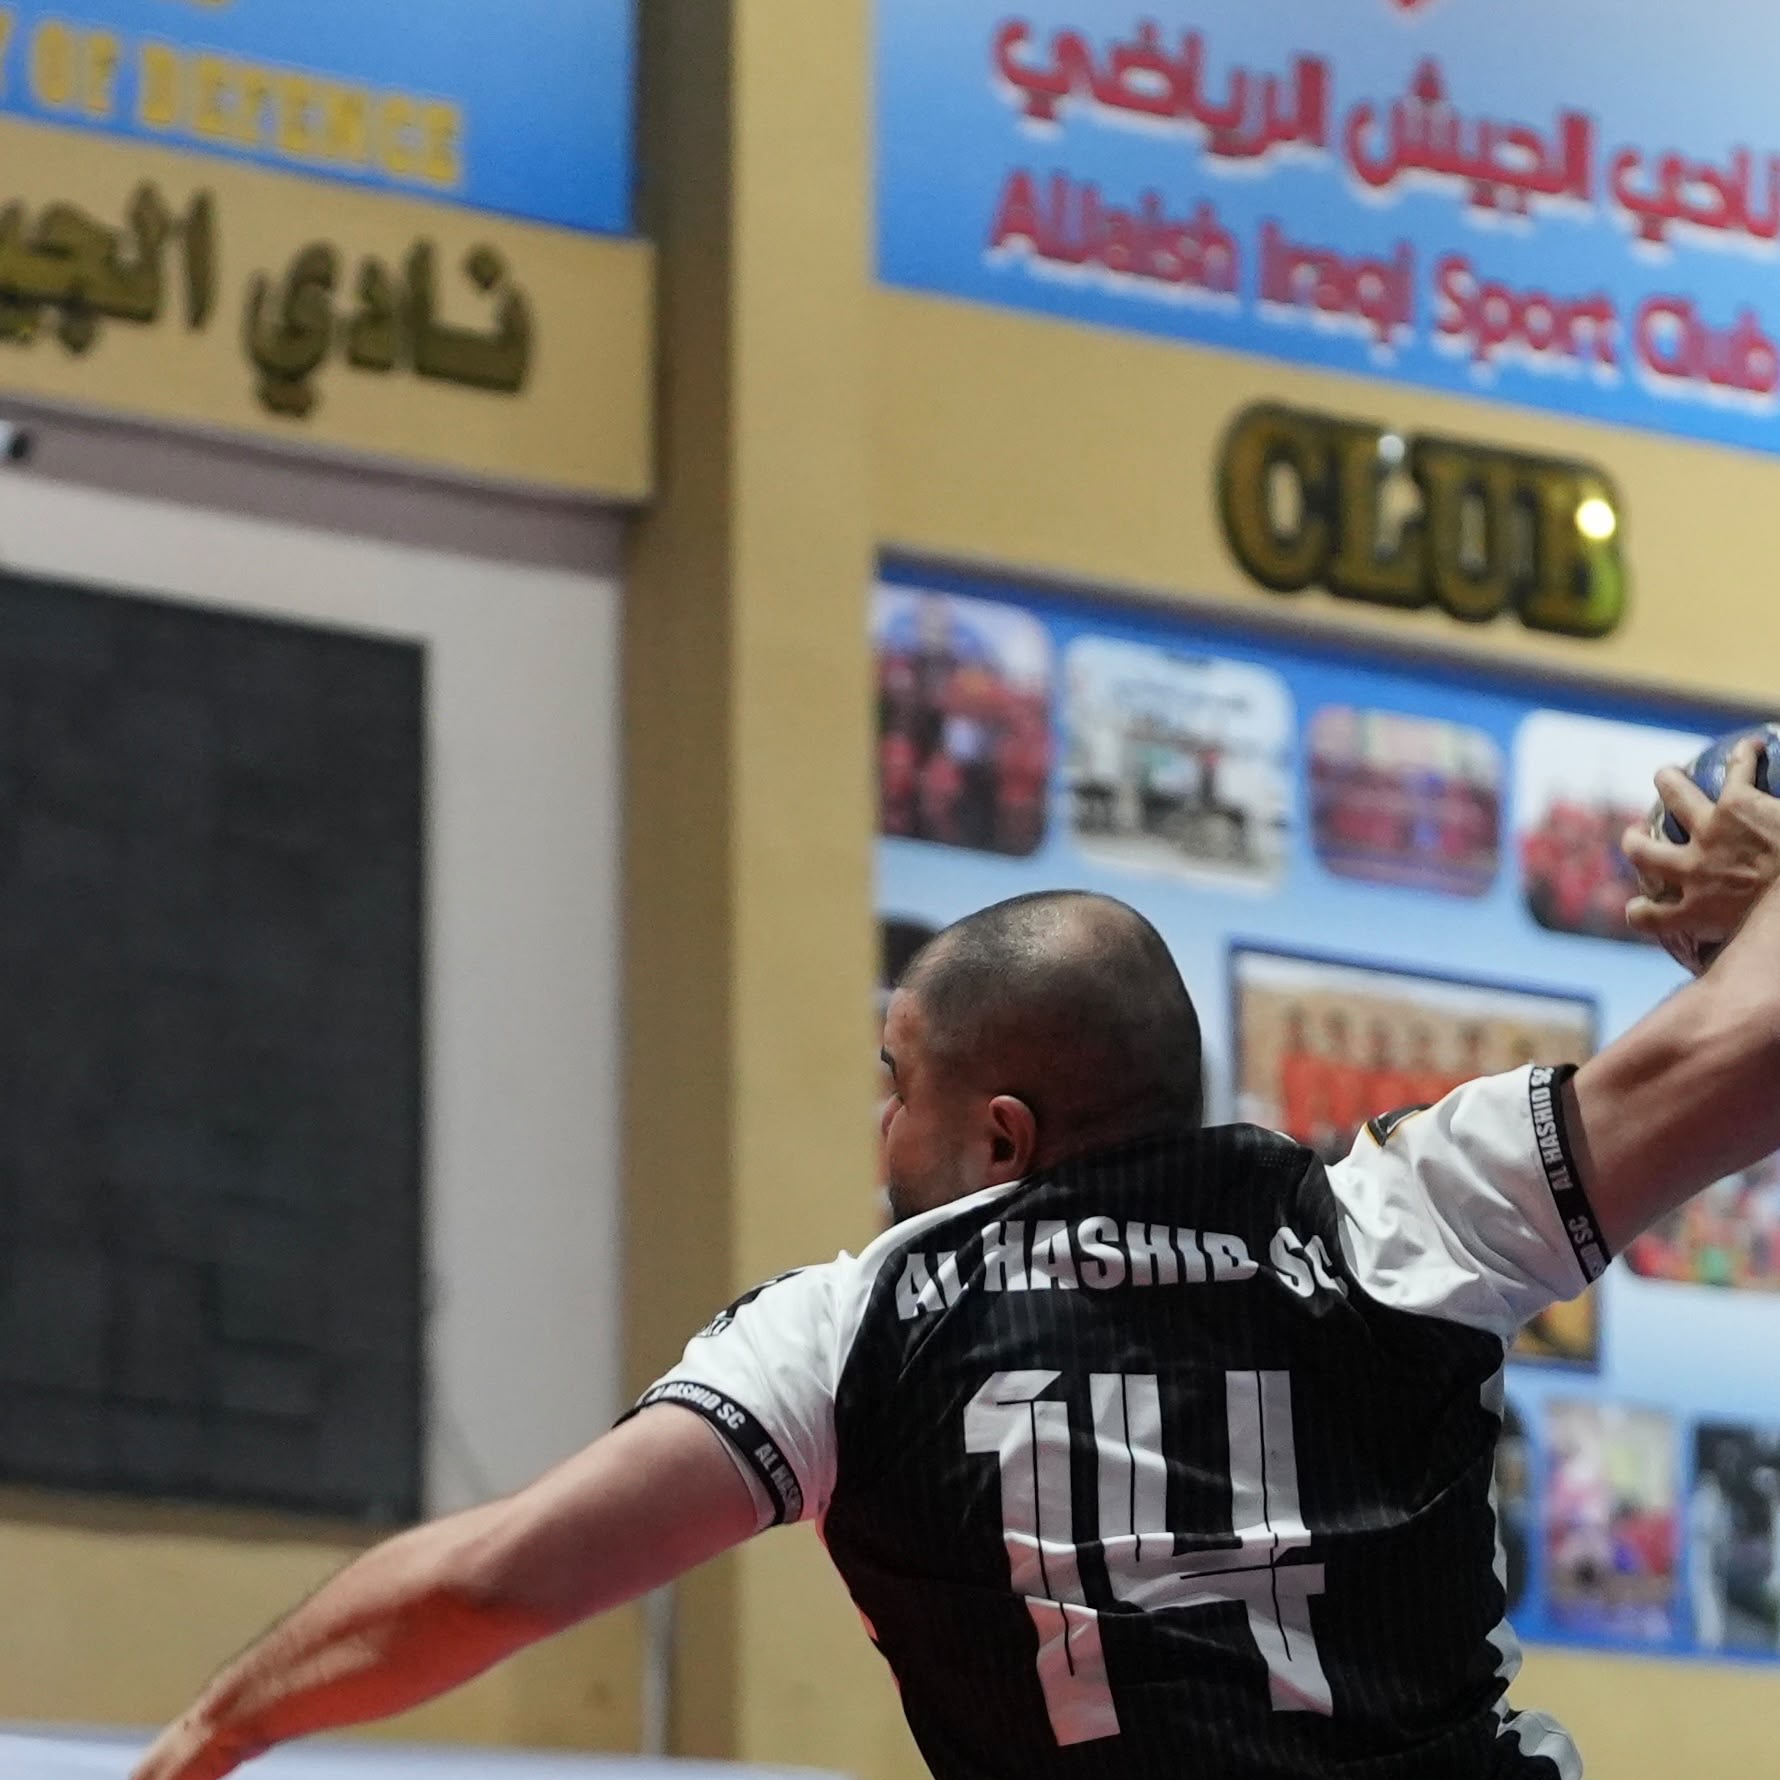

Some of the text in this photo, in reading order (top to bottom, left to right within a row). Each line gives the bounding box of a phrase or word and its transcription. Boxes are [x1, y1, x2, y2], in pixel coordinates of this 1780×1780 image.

[32, 20, 121, 114] OF
[139, 42, 461, 185] DEFENCE
[992, 16, 1327, 158] الرياضي
[1344, 55, 1593, 215] الجيش
[0, 178, 536, 419] نادي الجي
[1435, 253, 1623, 363] Sport
[1216, 400, 1629, 638] CLUB
[1531, 1086, 1565, 1166] HASHID
[981, 1215, 1260, 1293] HASHID
[1269, 1225, 1349, 1299] SC
[716, 1402, 747, 1431] SC
[754, 1441, 779, 1471] AL
[963, 1368, 1334, 1748] 14
